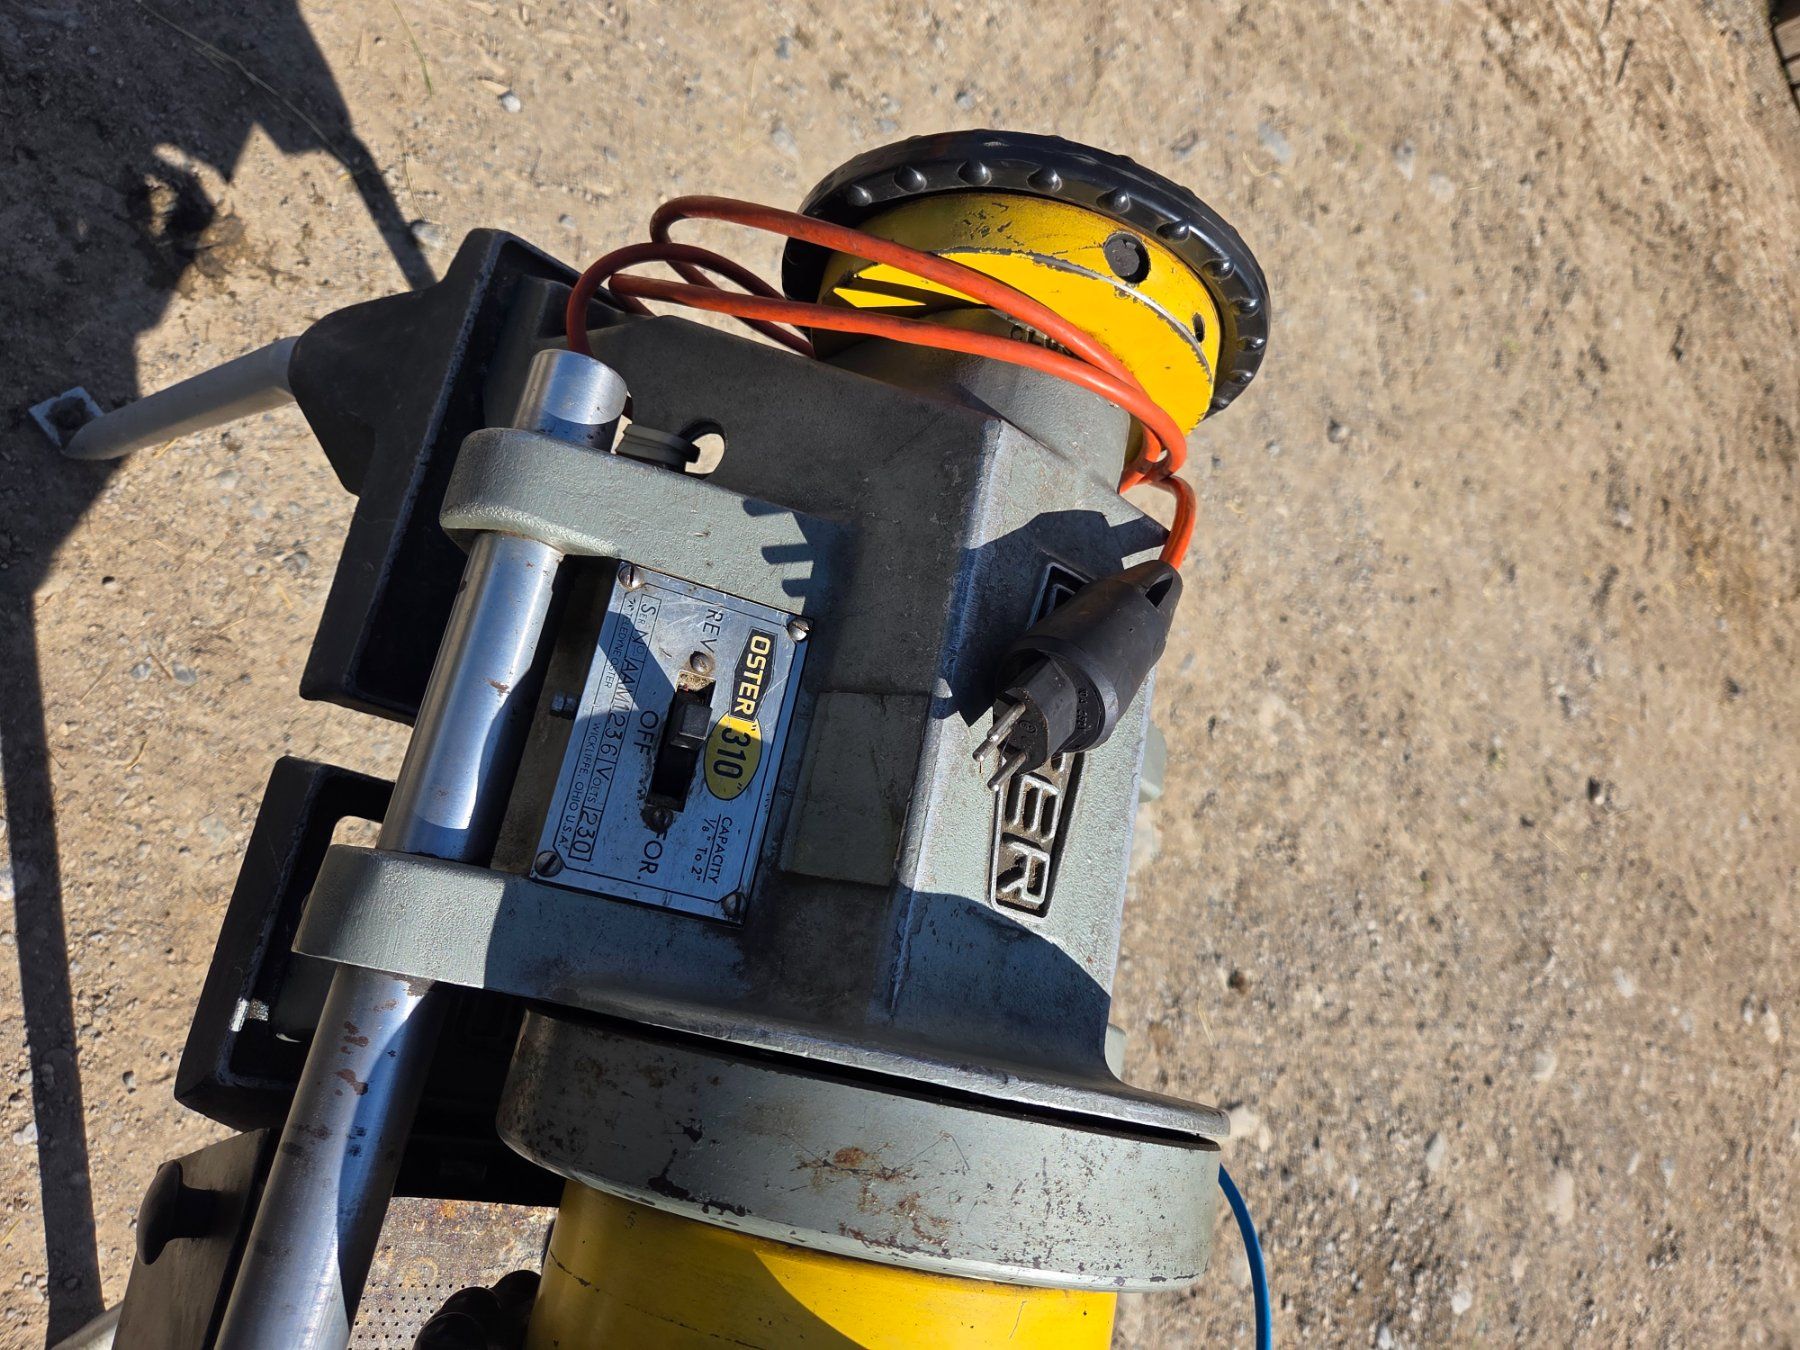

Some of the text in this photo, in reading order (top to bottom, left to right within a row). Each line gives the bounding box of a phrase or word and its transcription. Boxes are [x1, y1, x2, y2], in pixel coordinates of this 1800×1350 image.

[698, 608, 724, 653] REV
[602, 657, 620, 689] OSTER
[732, 633, 771, 715] OSTER
[633, 710, 659, 756] OFF
[568, 780, 584, 811] OHIO
[572, 809, 599, 854] 230
[707, 816, 733, 885] CAPACITY
